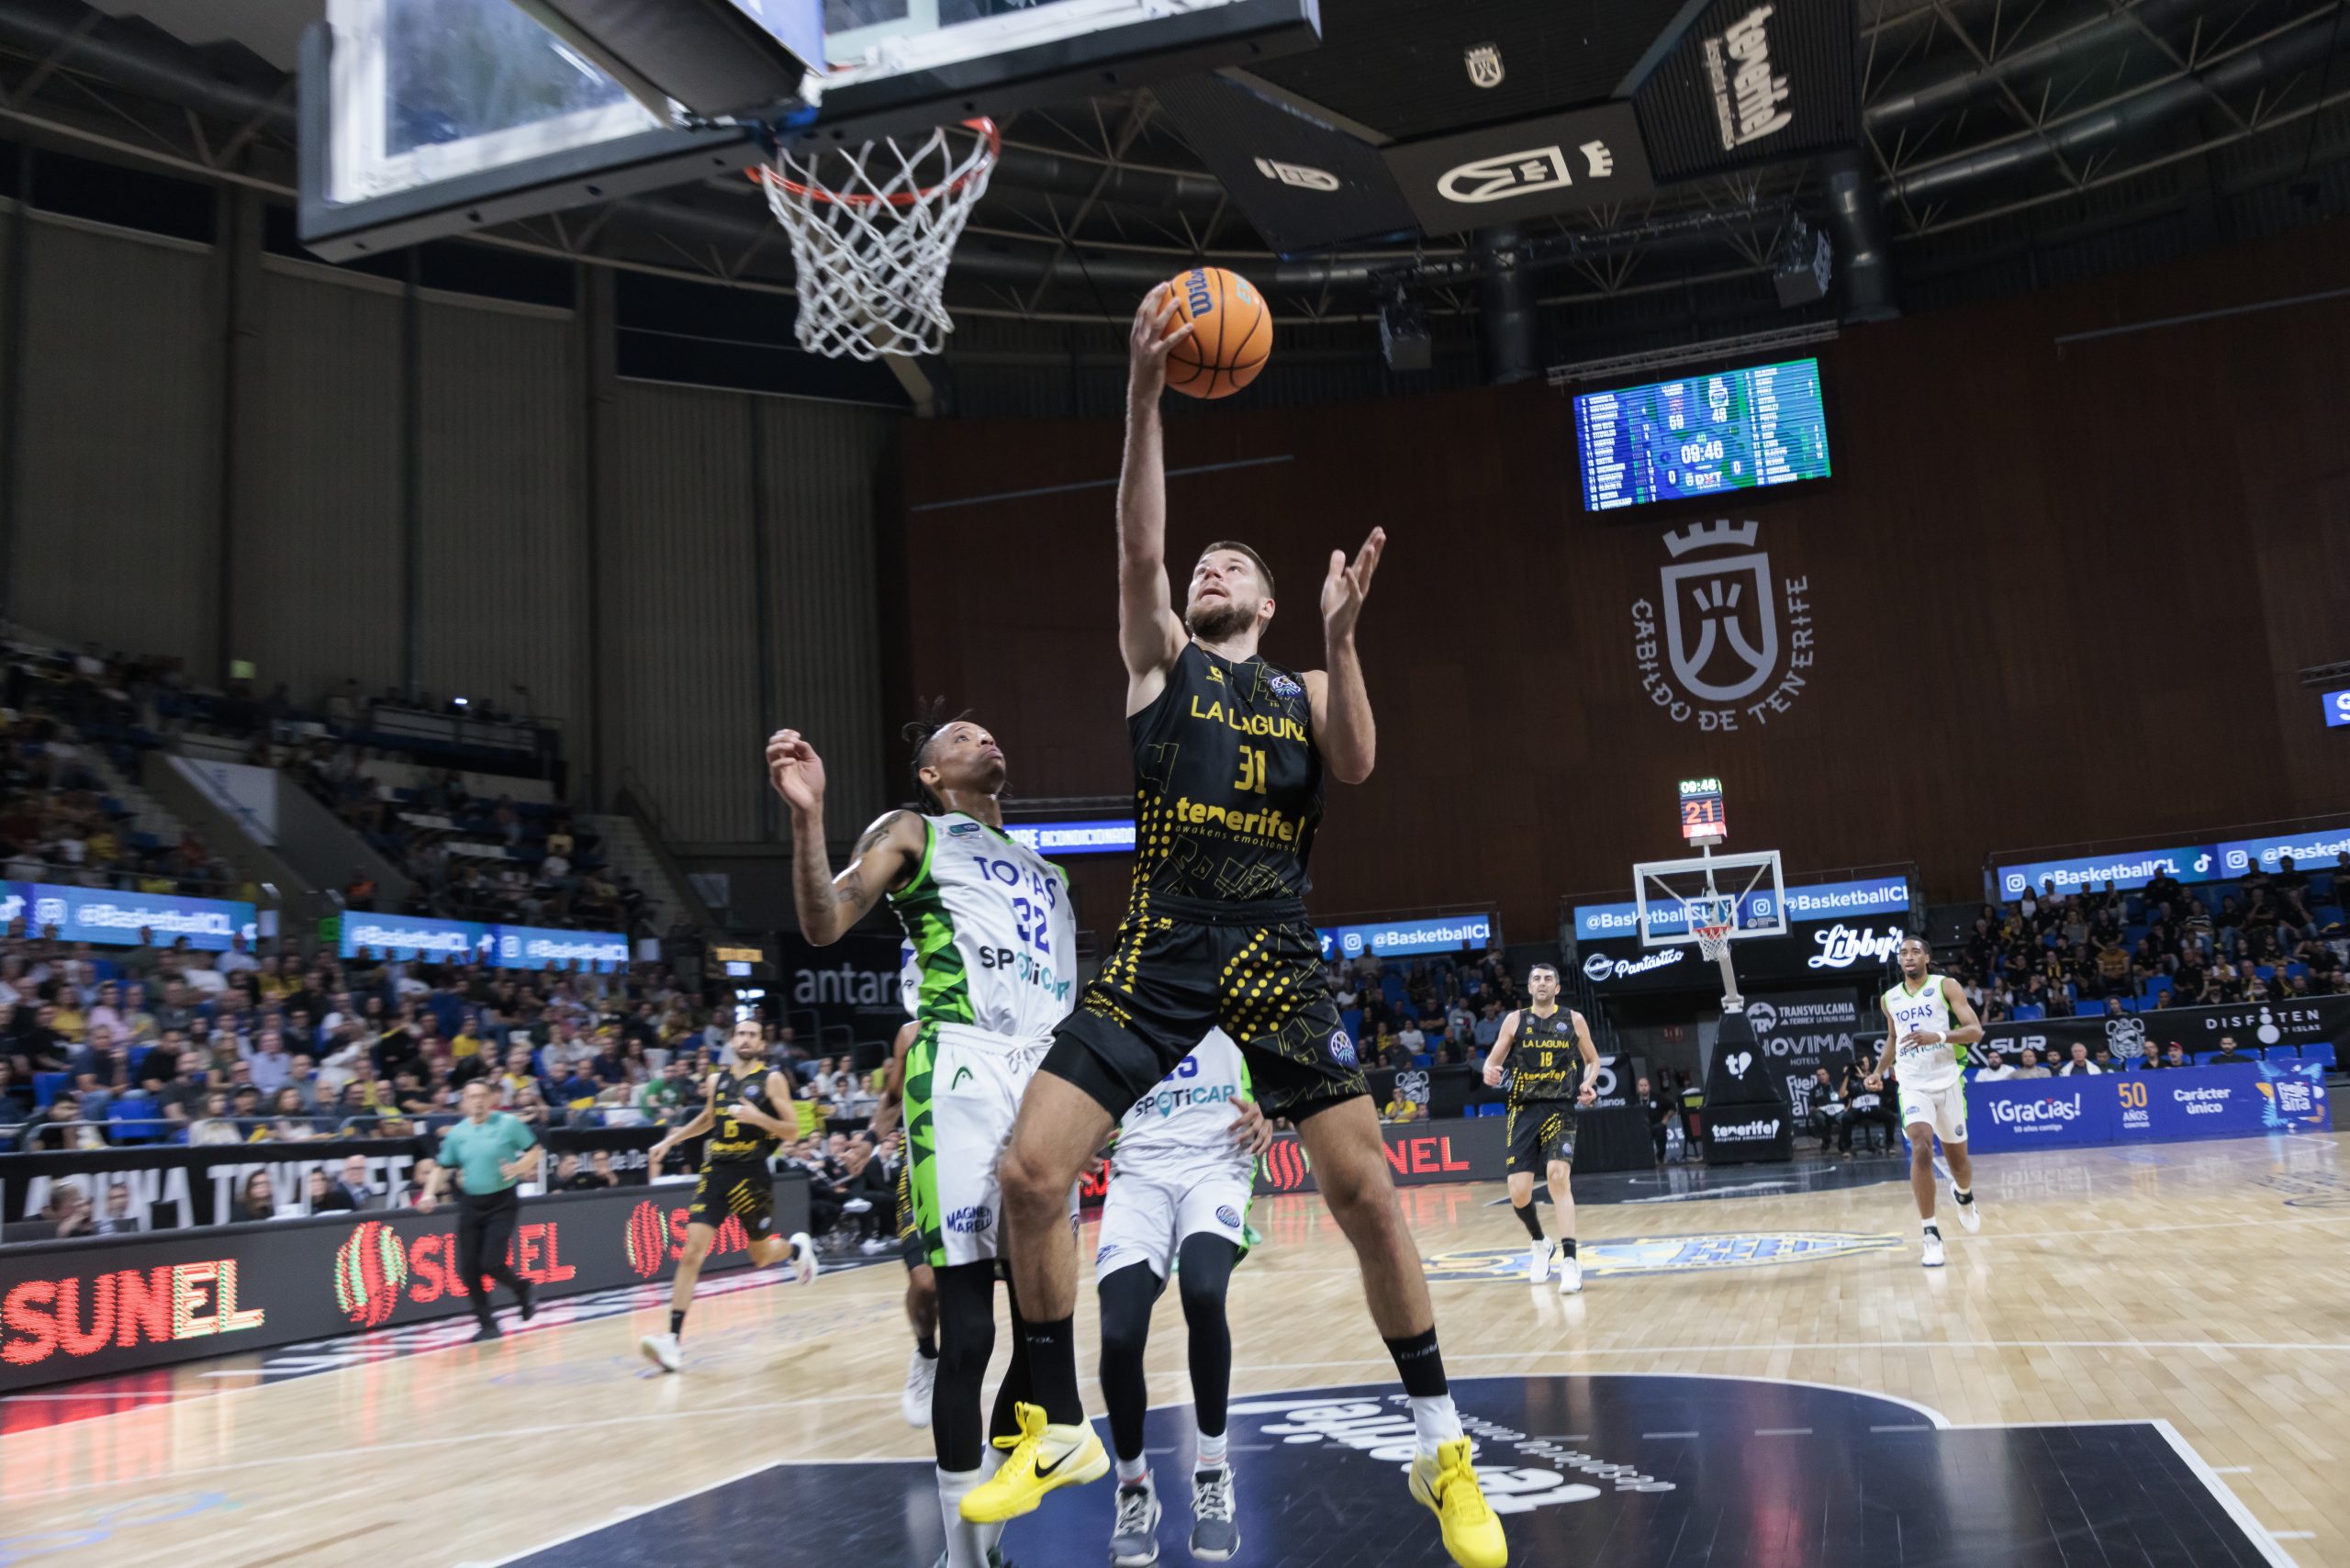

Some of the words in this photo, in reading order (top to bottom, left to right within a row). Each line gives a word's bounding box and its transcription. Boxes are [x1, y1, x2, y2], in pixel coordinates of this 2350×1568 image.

[1726, 5, 1792, 146] tenerife!
[1631, 599, 1691, 722] CABILDO
[1698, 710, 1738, 731] DE
[1747, 576, 1814, 724] TENERIFE
[1192, 695, 1224, 722] LA
[1234, 745, 1266, 795] 31
[1685, 801, 1714, 824] 21
[1177, 797, 1305, 852] tenerife!
[1175, 824, 1227, 840] awakens
[1234, 834, 1289, 852] emotions
[1779, 1002, 1854, 1018] TRANSVULCANIA
[2292, 1024, 2321, 1033] ISLAS
[1522, 1039, 1534, 1048] LA
[1536, 1039, 1570, 1049] LAGUNA
[1790, 1058, 1819, 1066] HOTELS
[2118, 1082, 2147, 1108] 50
[2174, 1088, 2232, 1102] Carácter
[2122, 1109, 2149, 1122] AÑOS
[2186, 1103, 2223, 1114] único
[1712, 1119, 1780, 1139] tenerife!
[1, 1259, 265, 1366] SUNEL
